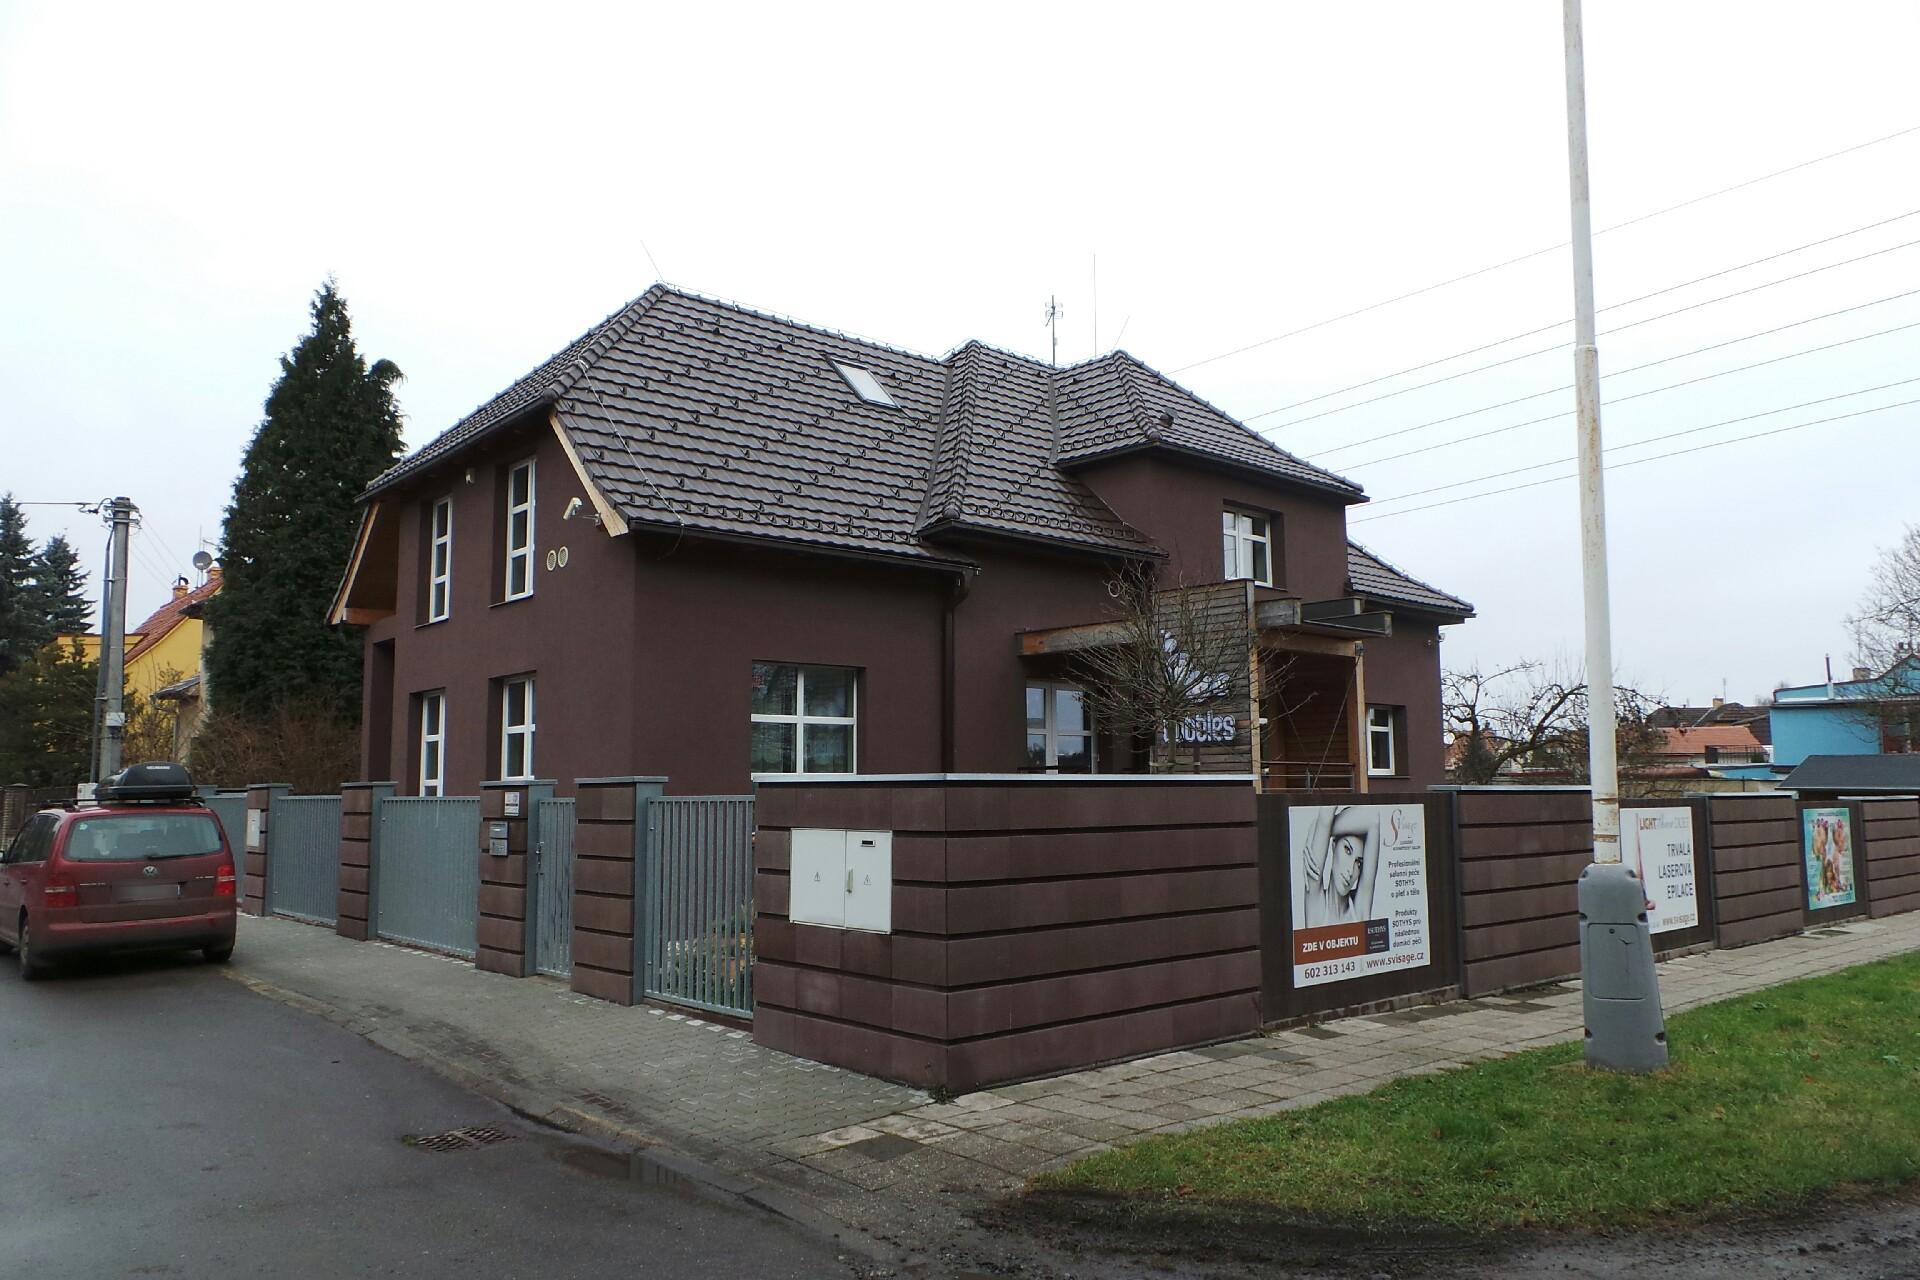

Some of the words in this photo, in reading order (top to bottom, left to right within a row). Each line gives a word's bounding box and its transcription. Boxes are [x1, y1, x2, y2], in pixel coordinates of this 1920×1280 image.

[1667, 883, 1693, 899] EPILACE
[1302, 942, 1318, 953] ZDE
[1319, 940, 1325, 950] V
[1325, 936, 1359, 950] OBJEKTU
[1366, 952, 1424, 968] www.svisage.cz
[1304, 967, 1320, 979] 602
[1323, 964, 1338, 976] 313
[1341, 961, 1356, 973] 143
